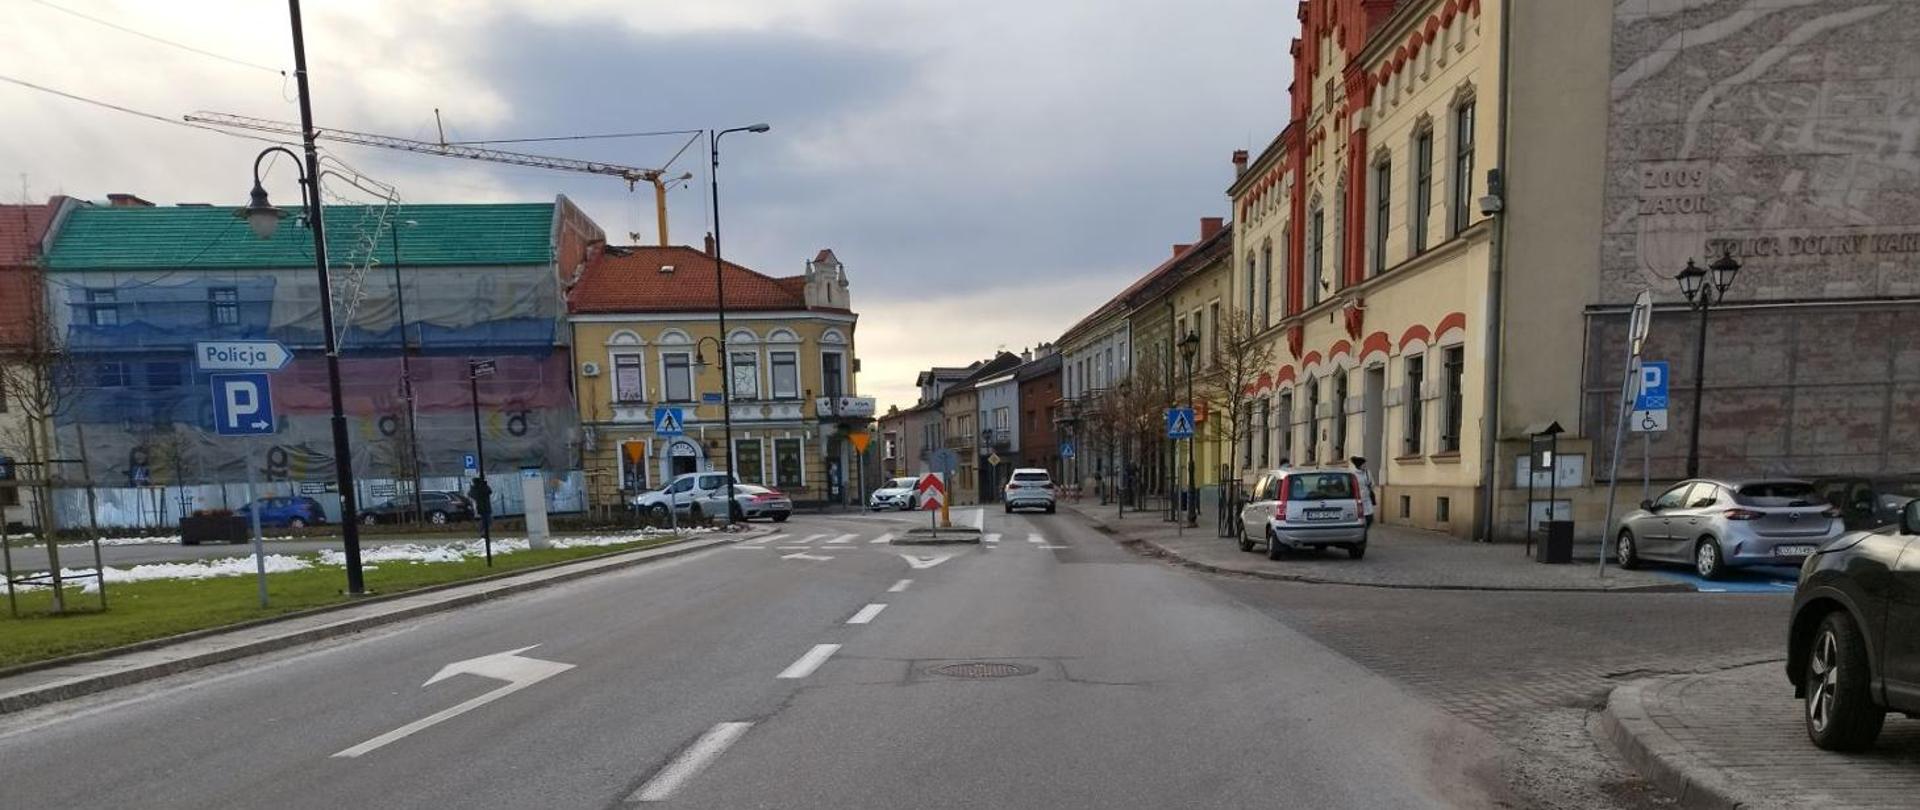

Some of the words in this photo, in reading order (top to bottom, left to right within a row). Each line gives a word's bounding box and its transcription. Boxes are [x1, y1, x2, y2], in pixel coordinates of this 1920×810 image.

[1643, 169, 1701, 189] 2009
[206, 346, 266, 366] Policja
[1641, 367, 1661, 396] P
[225, 381, 259, 428] P
[465, 456, 473, 467] P
